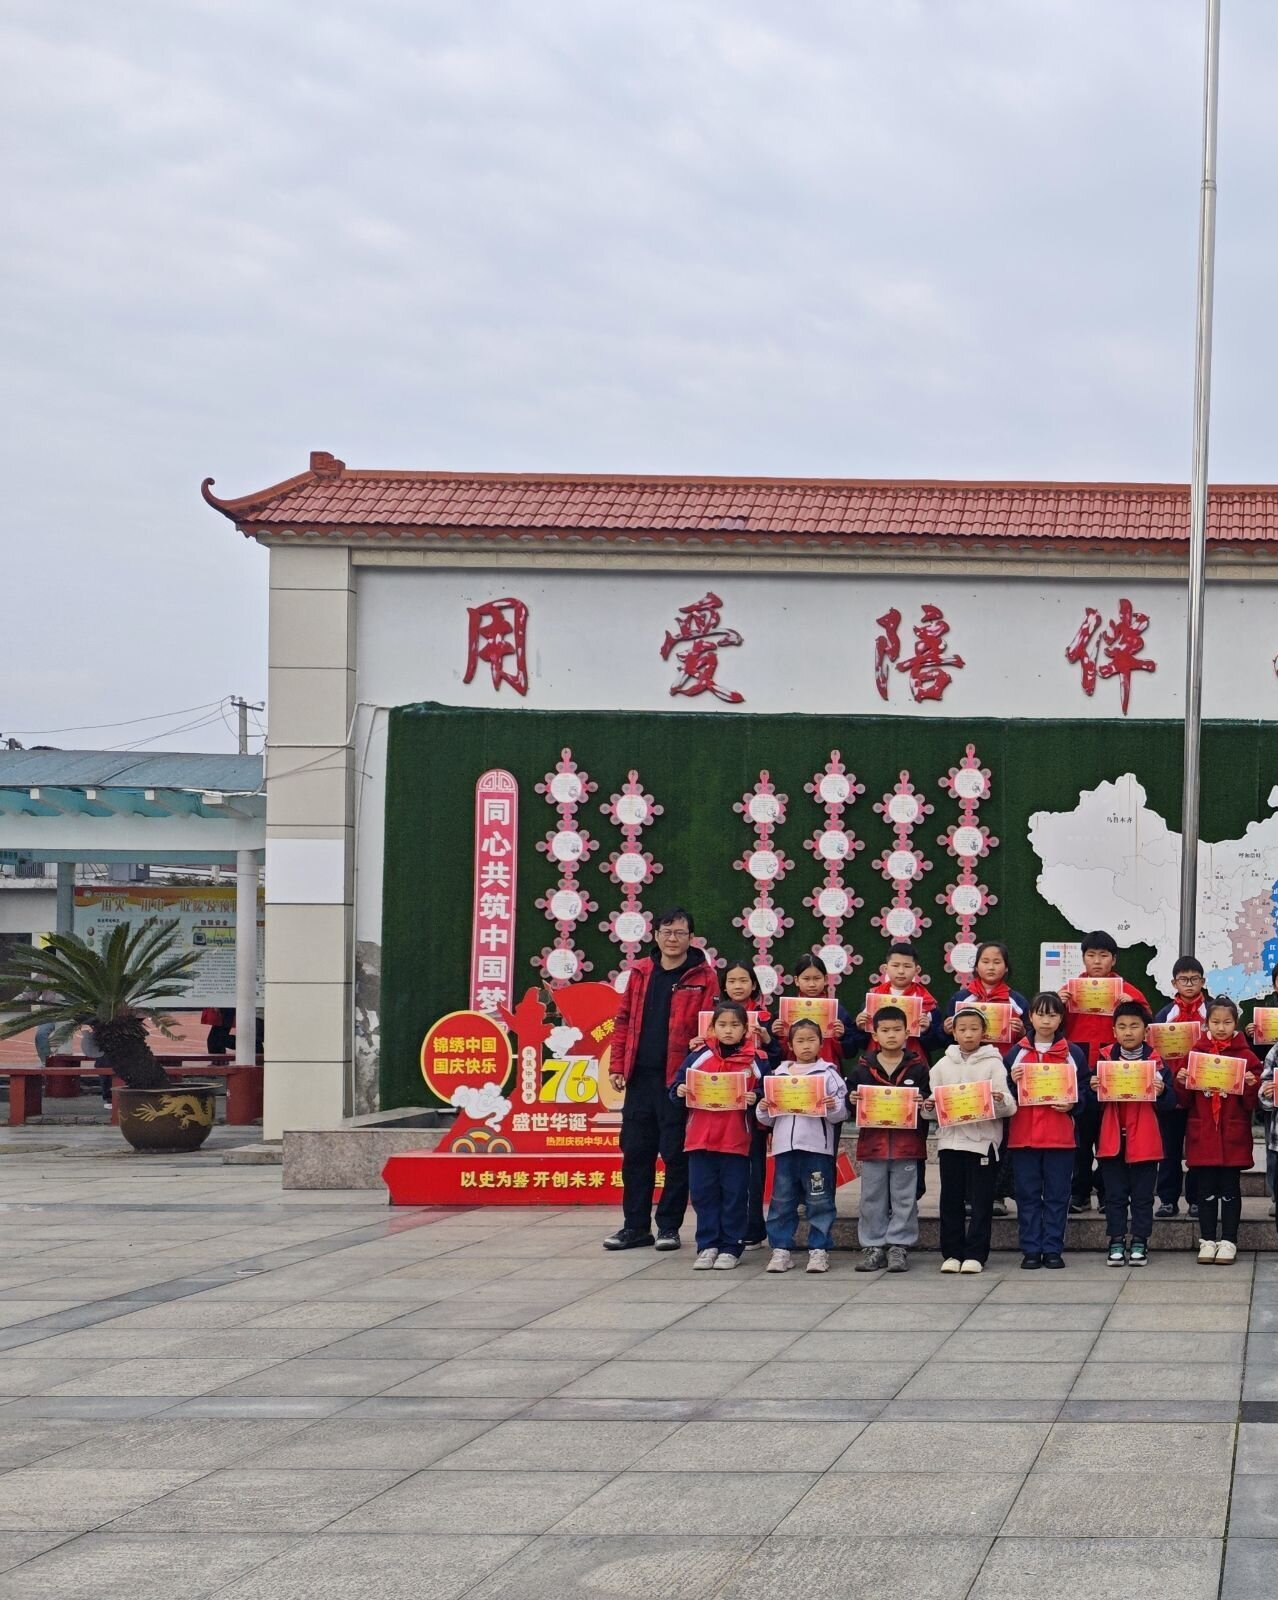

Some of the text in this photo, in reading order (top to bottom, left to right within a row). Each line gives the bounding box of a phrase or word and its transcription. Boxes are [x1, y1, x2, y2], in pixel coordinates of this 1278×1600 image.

[475, 797, 511, 1014] 同心共筑中国梦
[432, 1036, 498, 1055] 锦绣中国
[432, 1057, 498, 1076] 国庆快乐
[539, 1059, 598, 1103] 76
[511, 1112, 588, 1132] 盛世华诞
[460, 1170, 529, 1188] 以史为鉴
[533, 1170, 605, 1188] 开创未来
